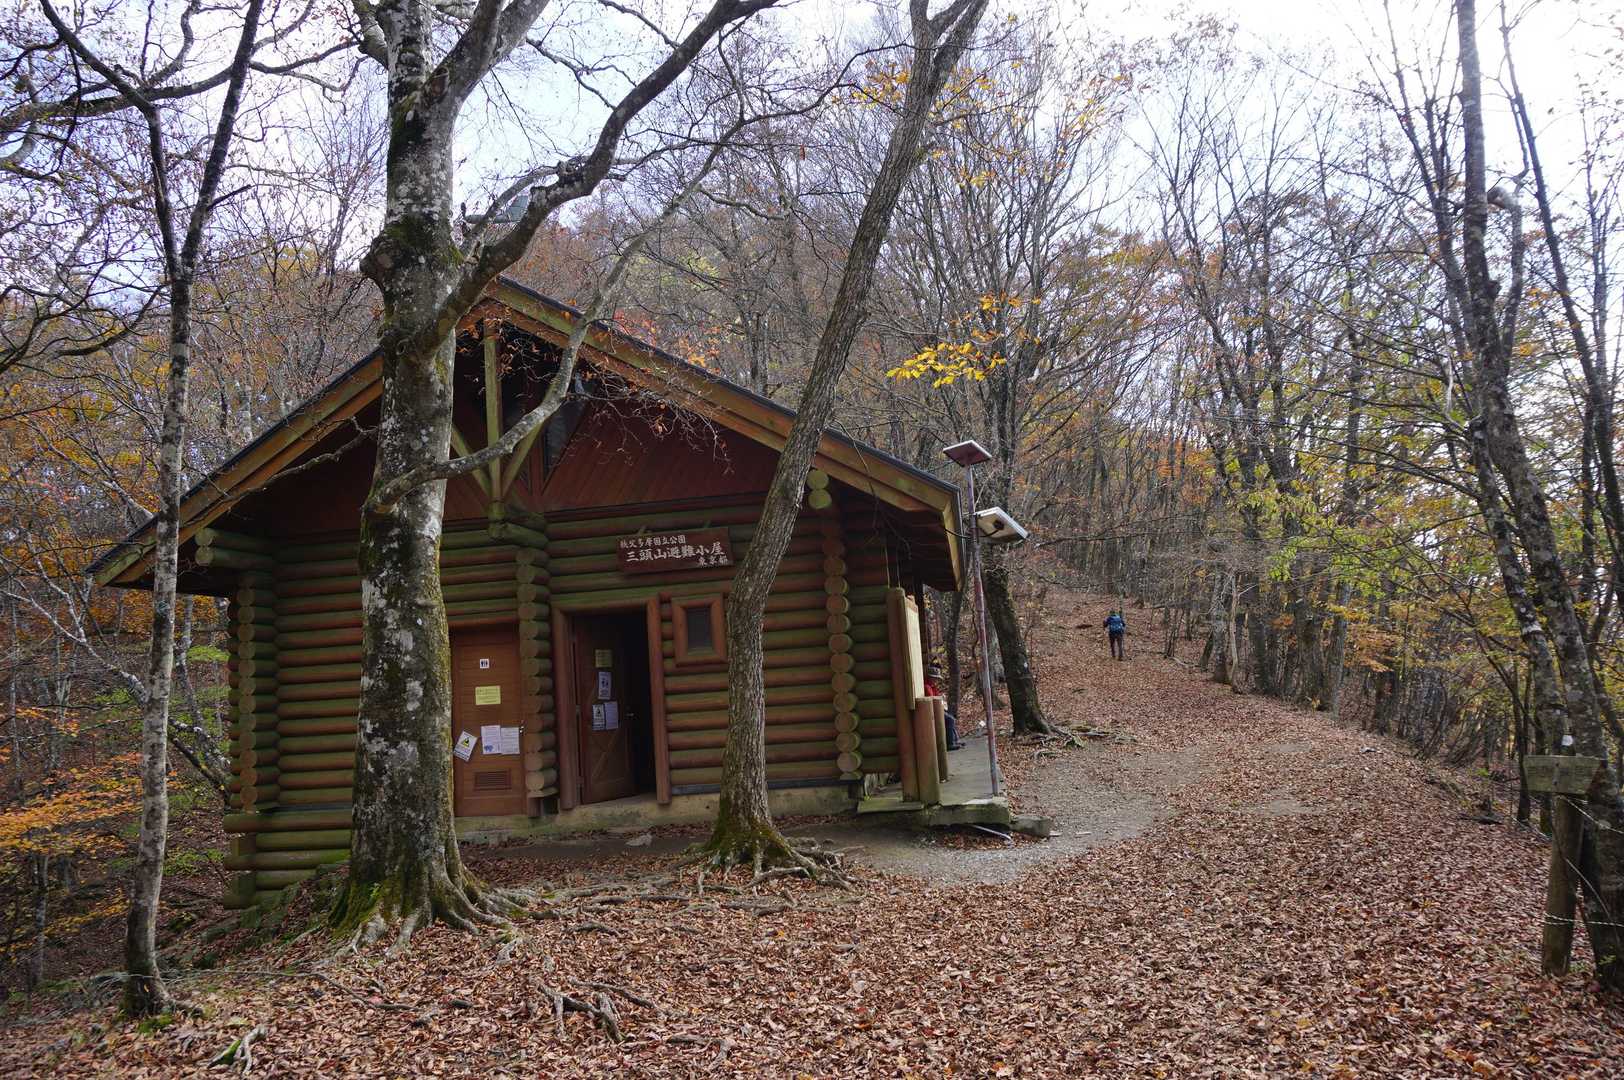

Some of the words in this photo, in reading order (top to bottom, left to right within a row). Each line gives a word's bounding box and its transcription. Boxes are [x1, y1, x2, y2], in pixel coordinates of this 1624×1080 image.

[626, 542, 725, 562] 三頭山避難小屋
[698, 556, 728, 566] 東京都
